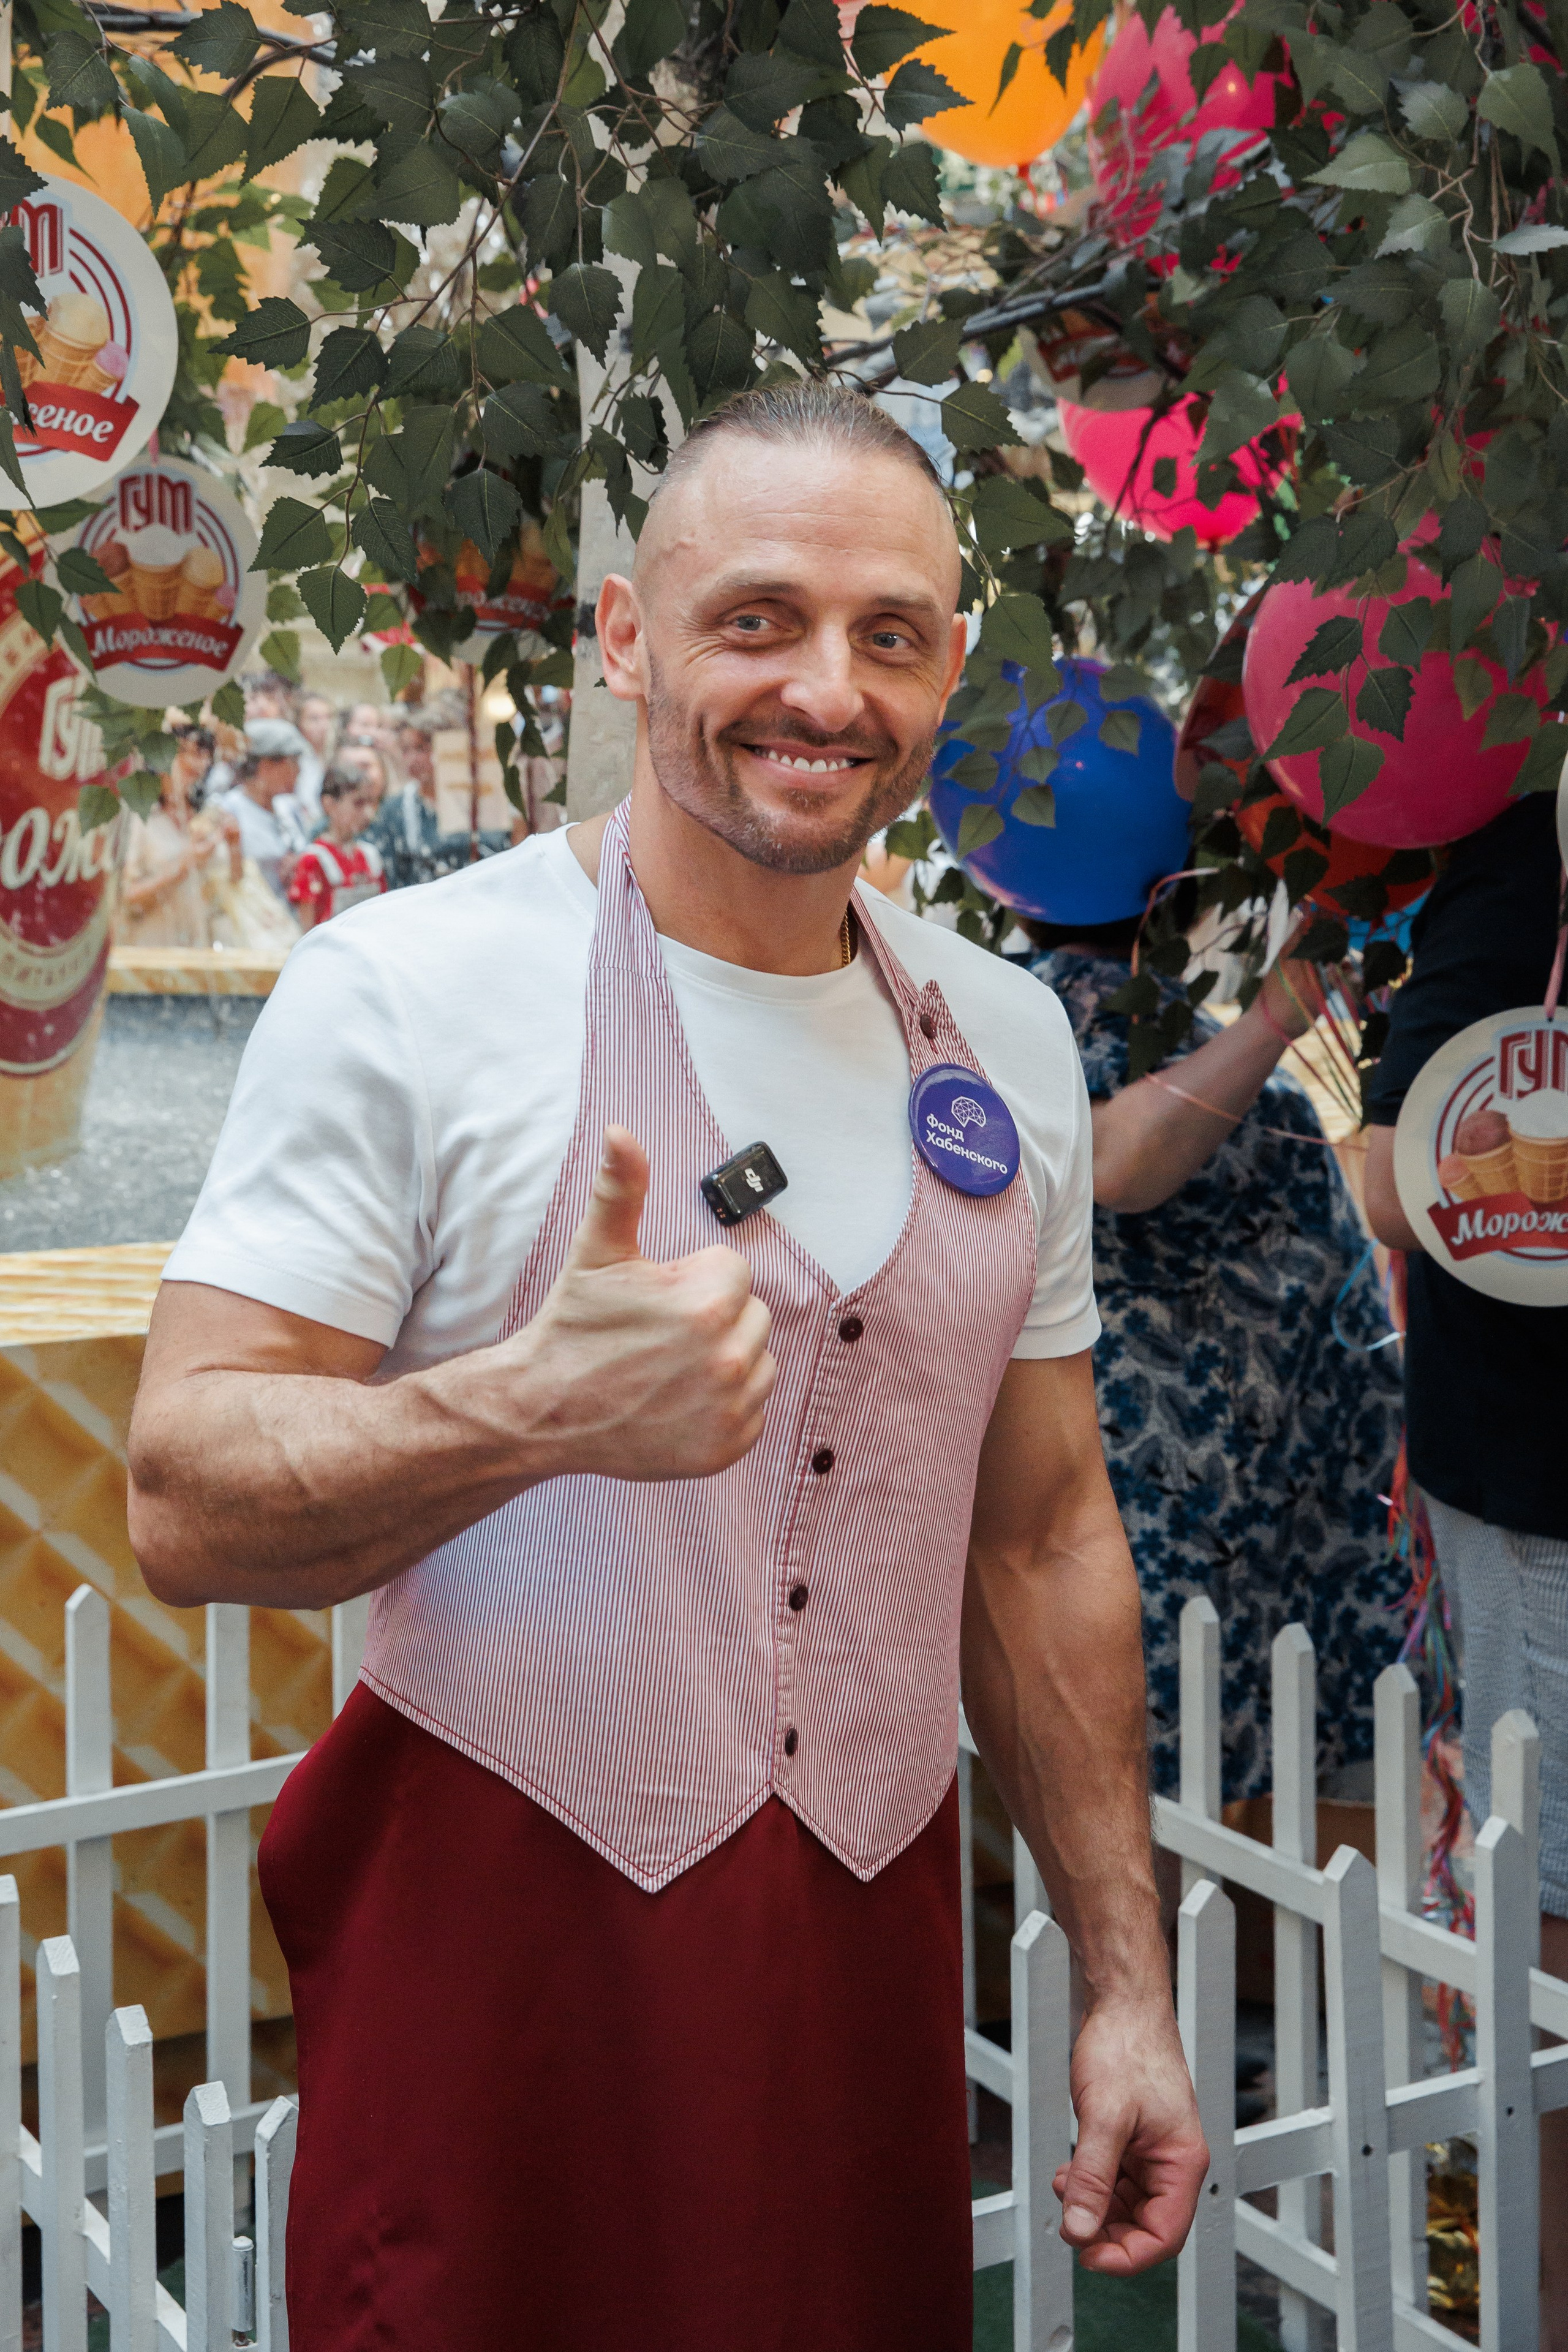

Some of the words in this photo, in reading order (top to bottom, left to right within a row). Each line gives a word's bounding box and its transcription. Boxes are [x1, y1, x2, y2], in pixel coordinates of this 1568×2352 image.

[119, 473, 195, 535] ГУМ
[926, 1113, 965, 1143] Фонд
[925, 1129, 1008, 1175] Хабенского
